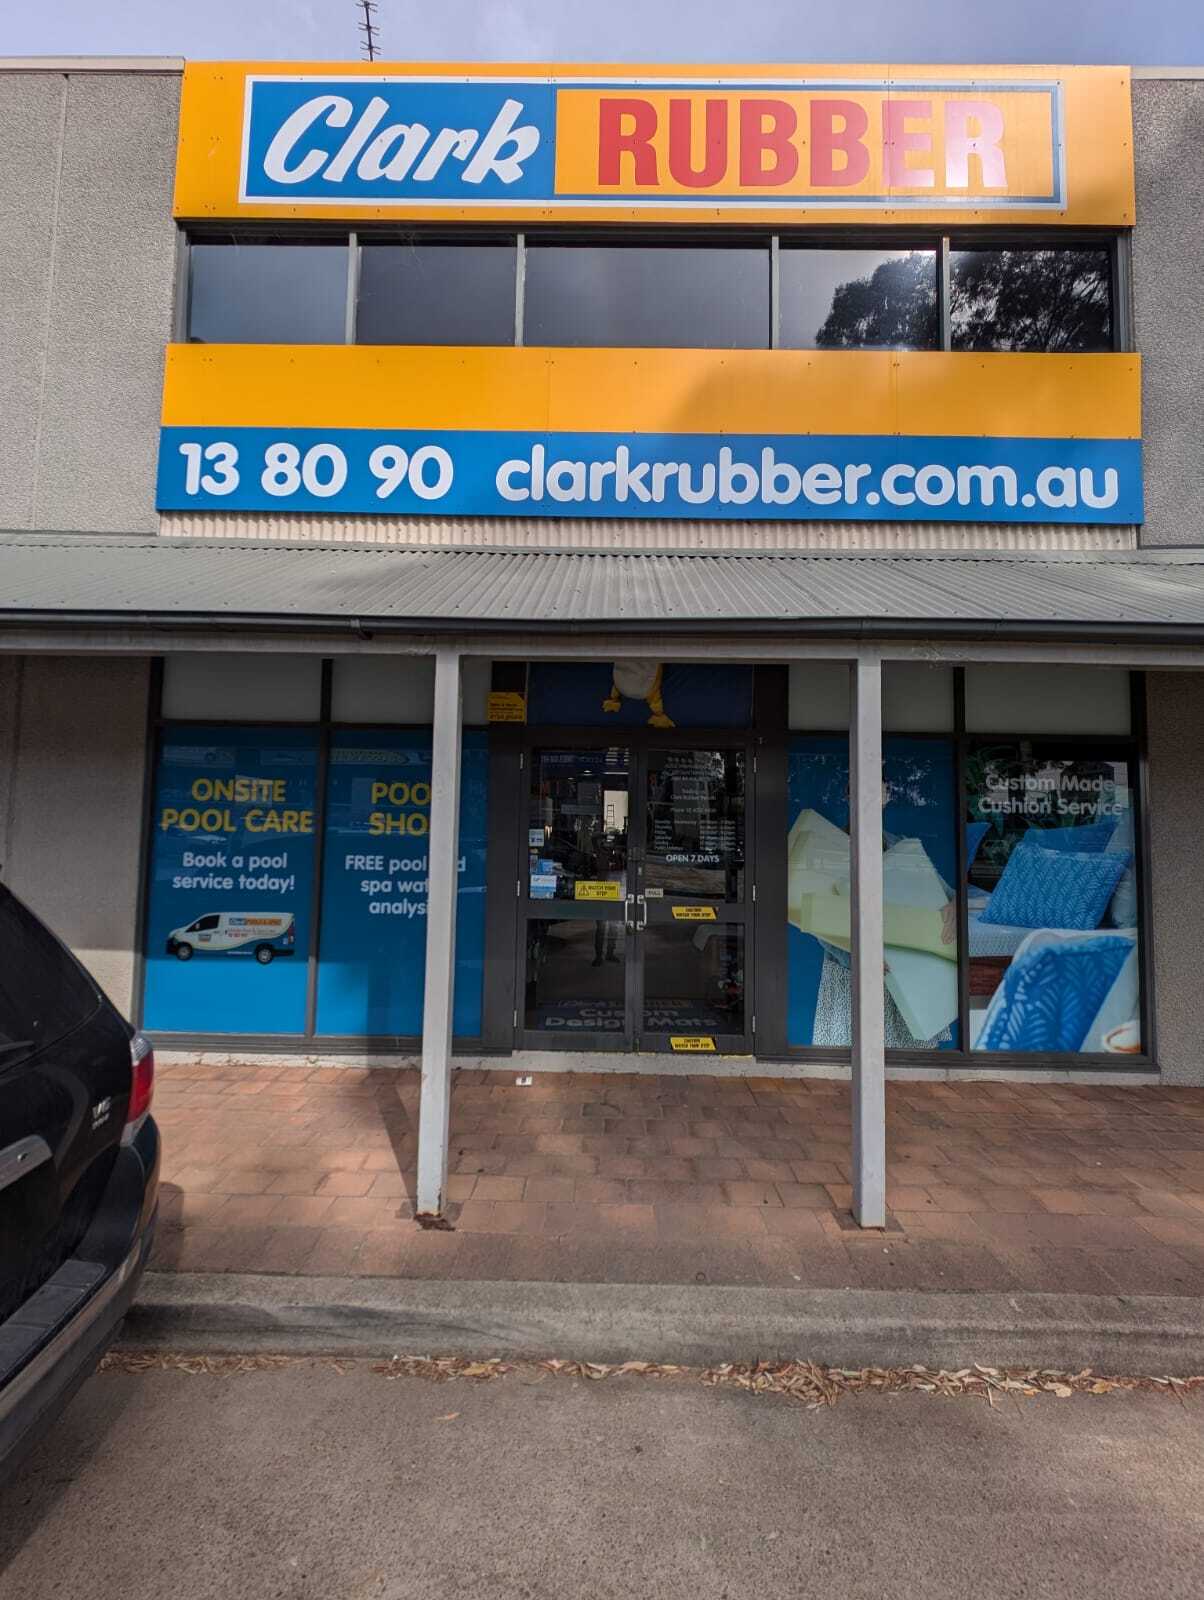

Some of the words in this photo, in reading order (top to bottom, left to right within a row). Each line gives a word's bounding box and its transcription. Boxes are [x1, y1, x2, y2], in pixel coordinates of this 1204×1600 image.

[263, 95, 540, 184] Clark
[598, 99, 1008, 190] RUBBER
[179, 442, 240, 496] 13
[261, 443, 347, 498] 80
[369, 445, 453, 500] 90
[495, 446, 1120, 509] clarkrubber.com.au
[191, 778, 287, 801] ONSITE
[371, 782, 432, 805] POO
[985, 774, 1055, 791] Custom
[1061, 775, 1117, 792] Made
[978, 797, 1050, 814] Cushion
[1056, 798, 1124, 816] Service
[160, 808, 236, 832] POOL
[245, 809, 313, 833] CARE
[368, 812, 430, 836] SHO
[182, 852, 227, 868] Book
[231, 856, 244, 868] a
[249, 852, 288, 872] pool
[345, 855, 384, 871] FREE
[389, 855, 427, 875] pool
[665, 854, 689, 863] OPEN
[691, 854, 696, 863] 7
[698, 854, 720, 863] DAYS
[172, 873, 234, 889] service
[239, 874, 296, 894] today!
[360, 880, 393, 896] spa
[397, 878, 430, 893] wat
[369, 898, 429, 919] analys
[578, 1008, 679, 1018] Cusom
